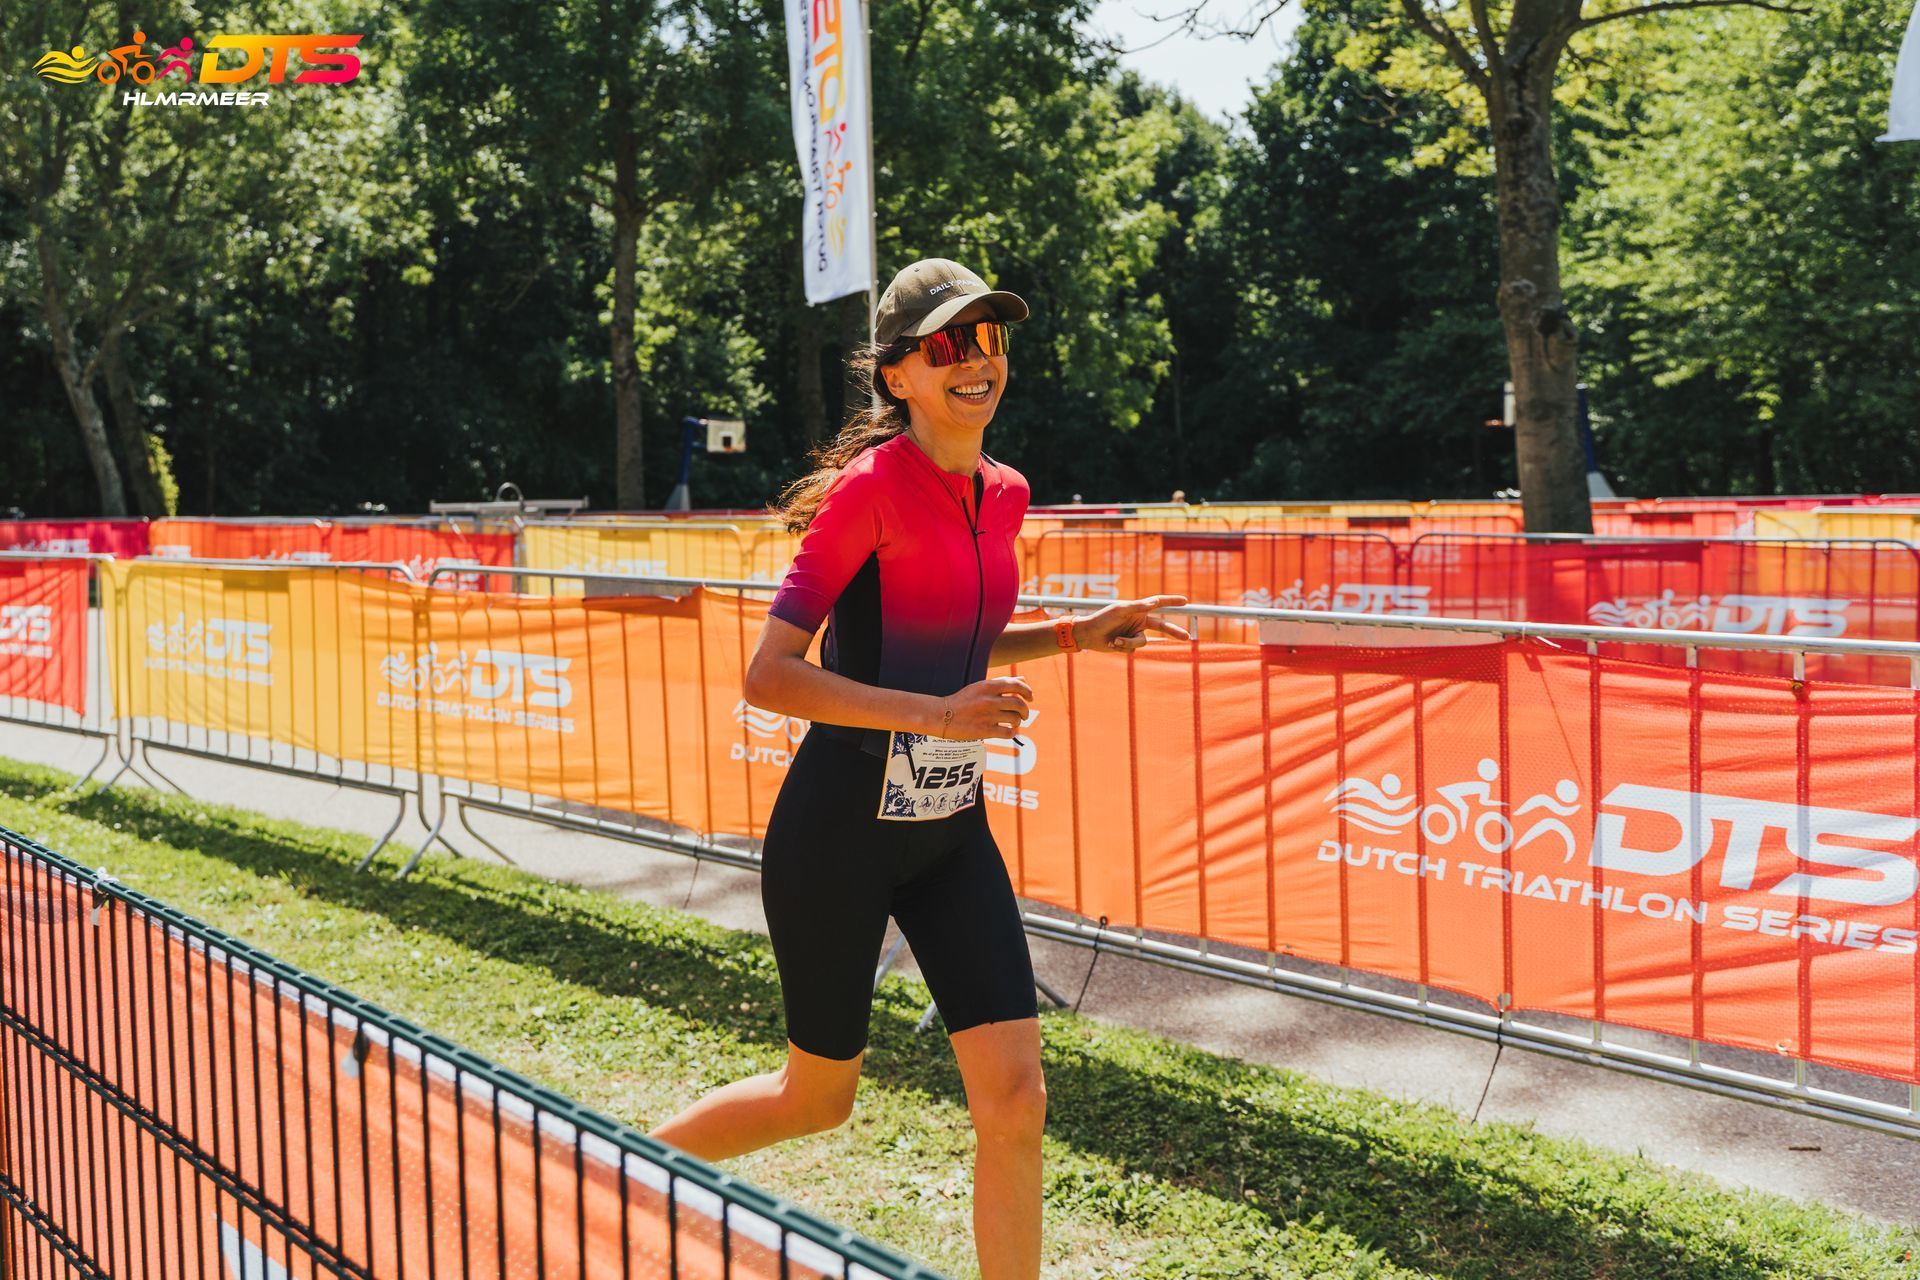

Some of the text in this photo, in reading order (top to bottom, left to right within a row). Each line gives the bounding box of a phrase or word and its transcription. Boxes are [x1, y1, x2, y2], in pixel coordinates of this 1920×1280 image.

[930, 280, 954, 296] DAILY
[1040, 574, 1120, 600] DTS
[1332, 583, 1432, 617] DTS
[1712, 594, 1852, 638] DTS
[205, 617, 272, 665] DTS
[470, 649, 572, 708] DTS
[914, 761, 977, 790] 1255
[983, 781, 1040, 810] RIES
[1588, 782, 1920, 907] DTS
[1316, 839, 1919, 954] DUTCH TRIATHLON SERIES
